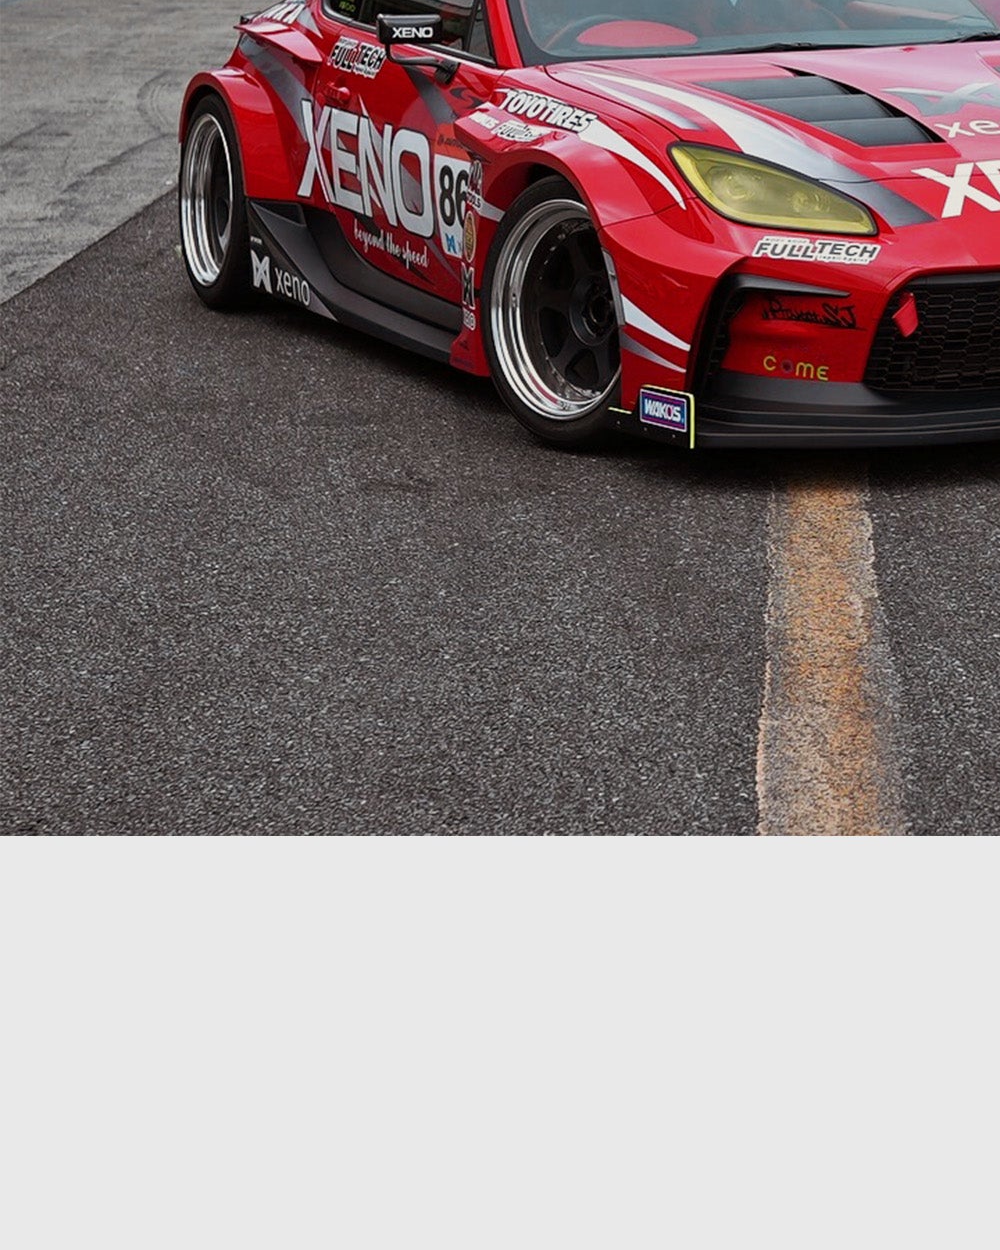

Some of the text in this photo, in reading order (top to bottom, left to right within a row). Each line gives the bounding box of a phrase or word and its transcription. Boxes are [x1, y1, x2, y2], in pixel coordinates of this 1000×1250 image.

[392, 26, 434, 39] XENO
[297, 99, 434, 238] XENO
[439, 165, 468, 228] 86
[354, 218, 429, 269] beyond the speed
[274, 267, 310, 306] xeno
